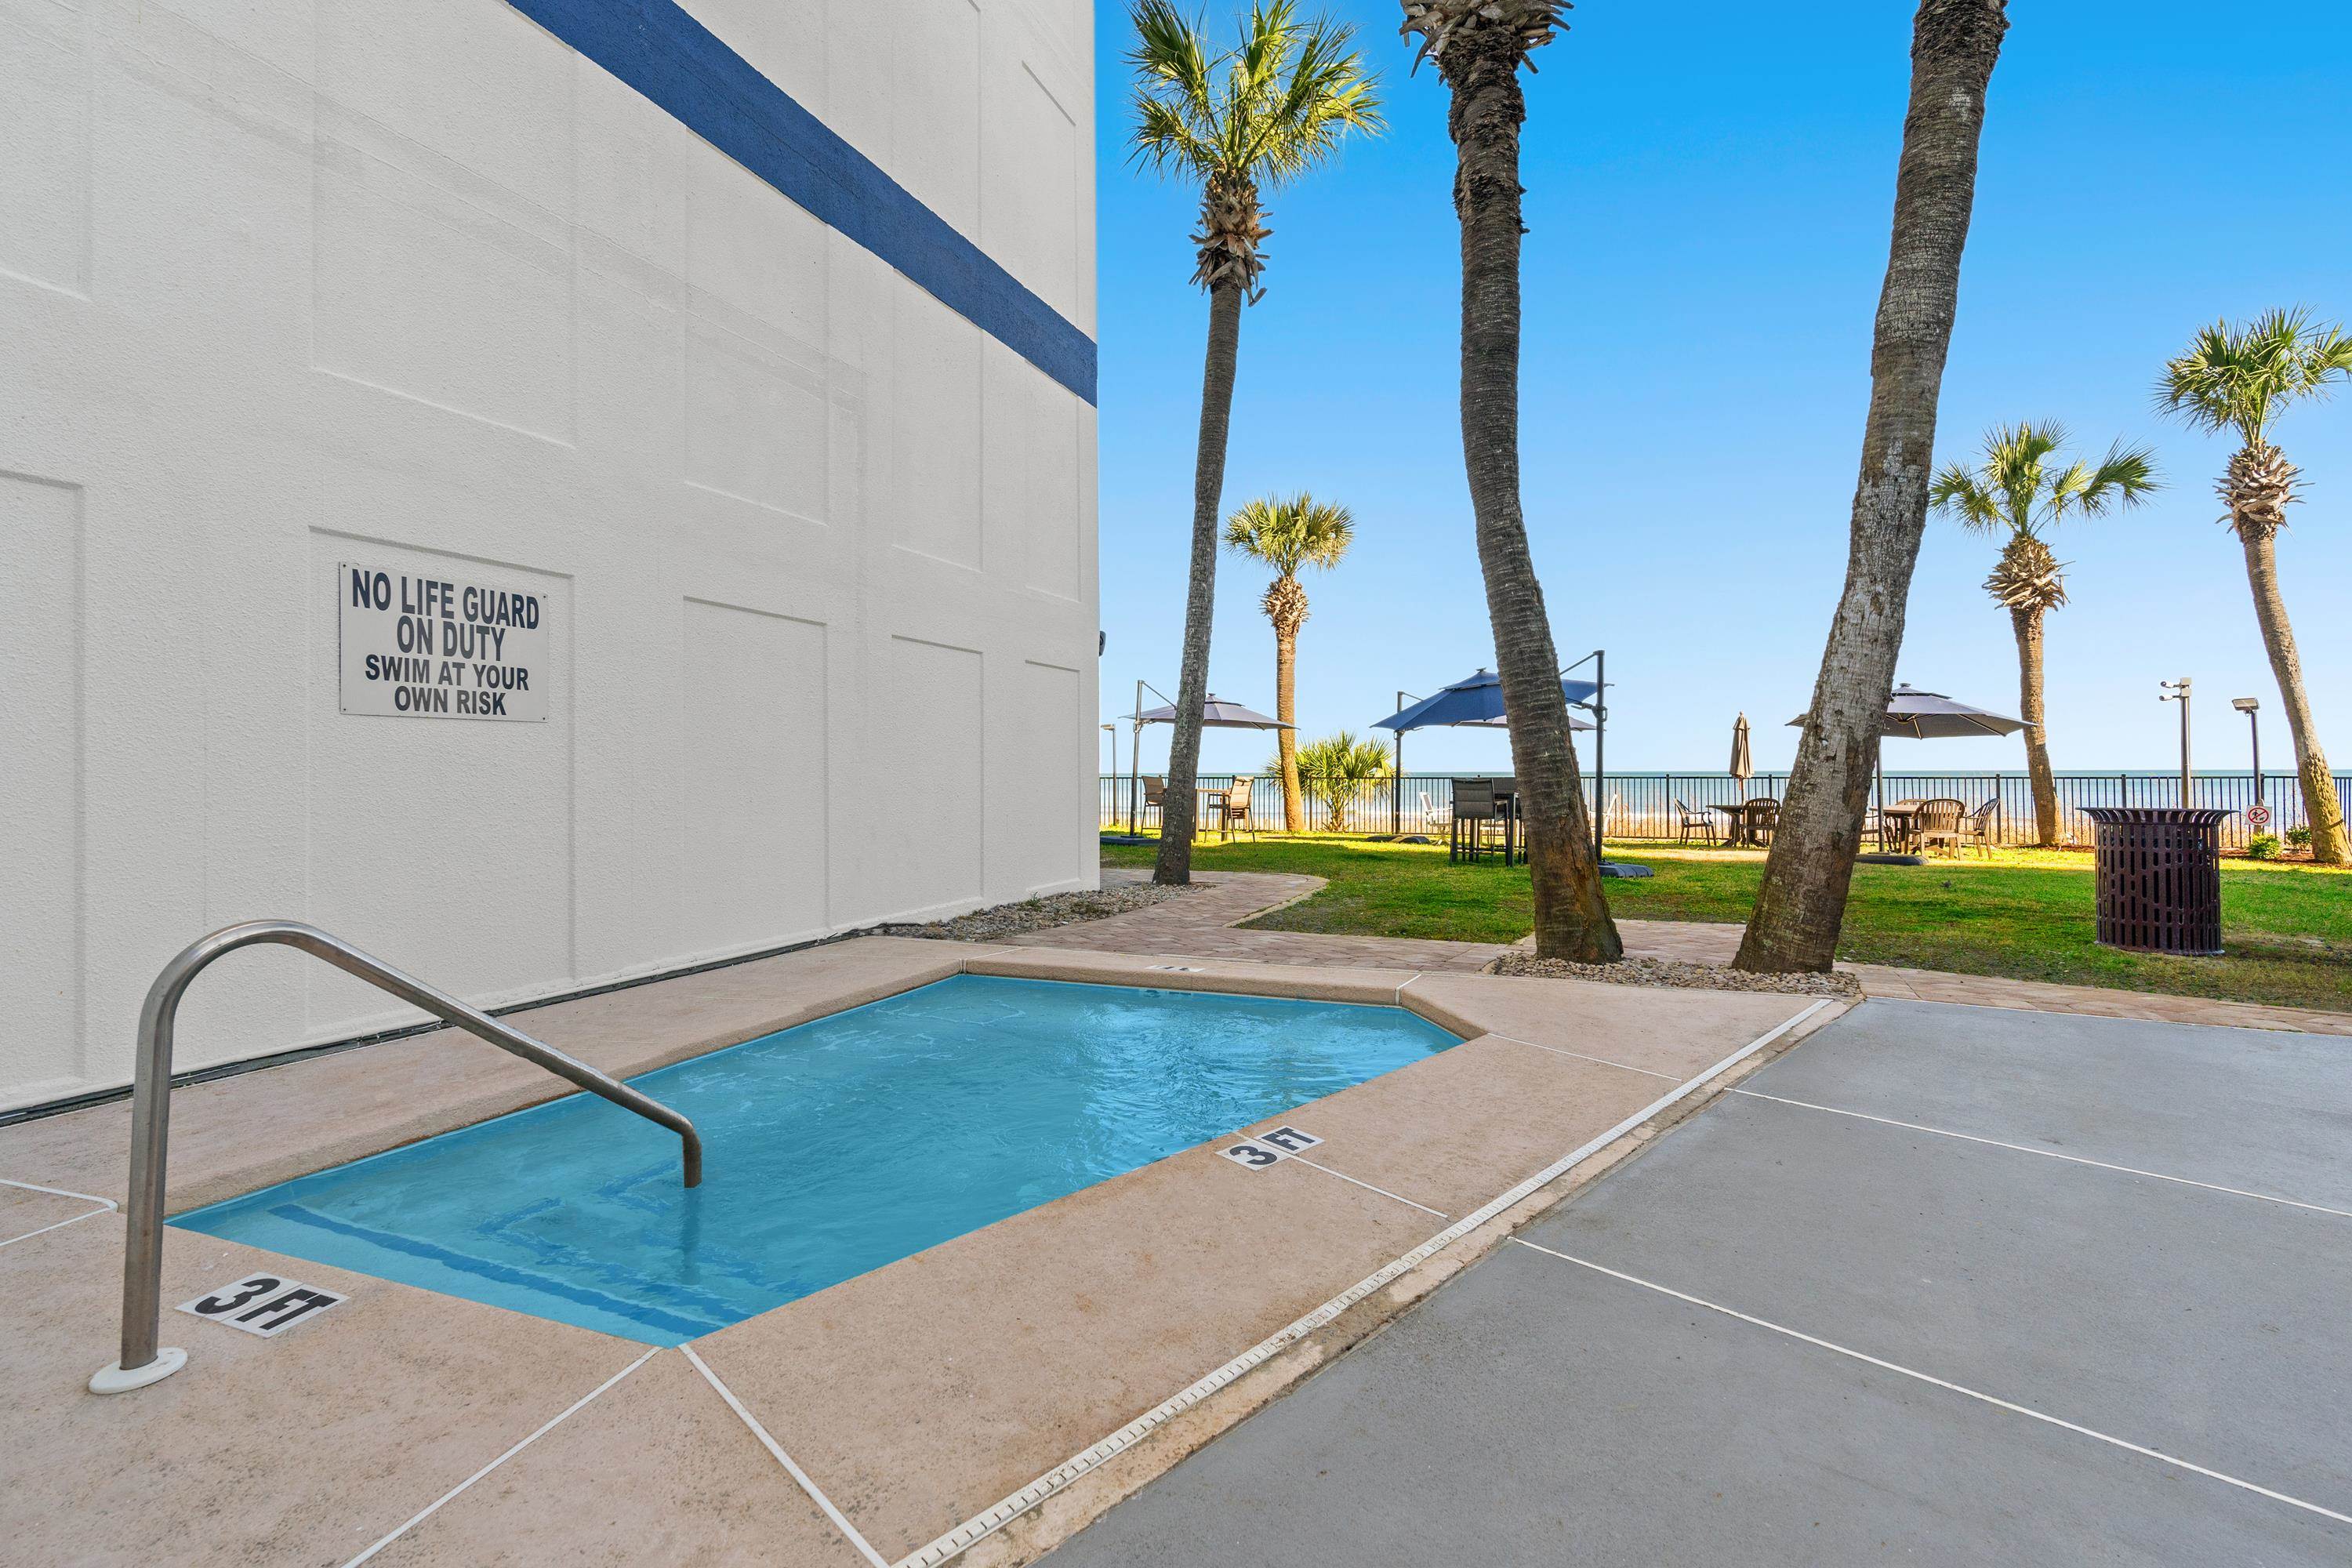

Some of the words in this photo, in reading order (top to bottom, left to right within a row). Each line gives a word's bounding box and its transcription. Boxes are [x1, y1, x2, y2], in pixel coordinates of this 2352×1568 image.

[352, 568, 391, 612] NO
[401, 575, 455, 619] LIFE
[463, 586, 539, 630] GUARD
[397, 615, 433, 655] ON
[443, 620, 506, 662] DUTY
[365, 654, 430, 684] SWIM
[437, 660, 466, 686] AT
[472, 663, 529, 691] YOUR
[394, 685, 448, 713] OWN
[456, 689, 506, 716] RISK
[1229, 1145, 1278, 1166] 3
[1261, 1127, 1316, 1152] FT
[194, 1278, 281, 1314] 3
[234, 1288, 339, 1330] FT
